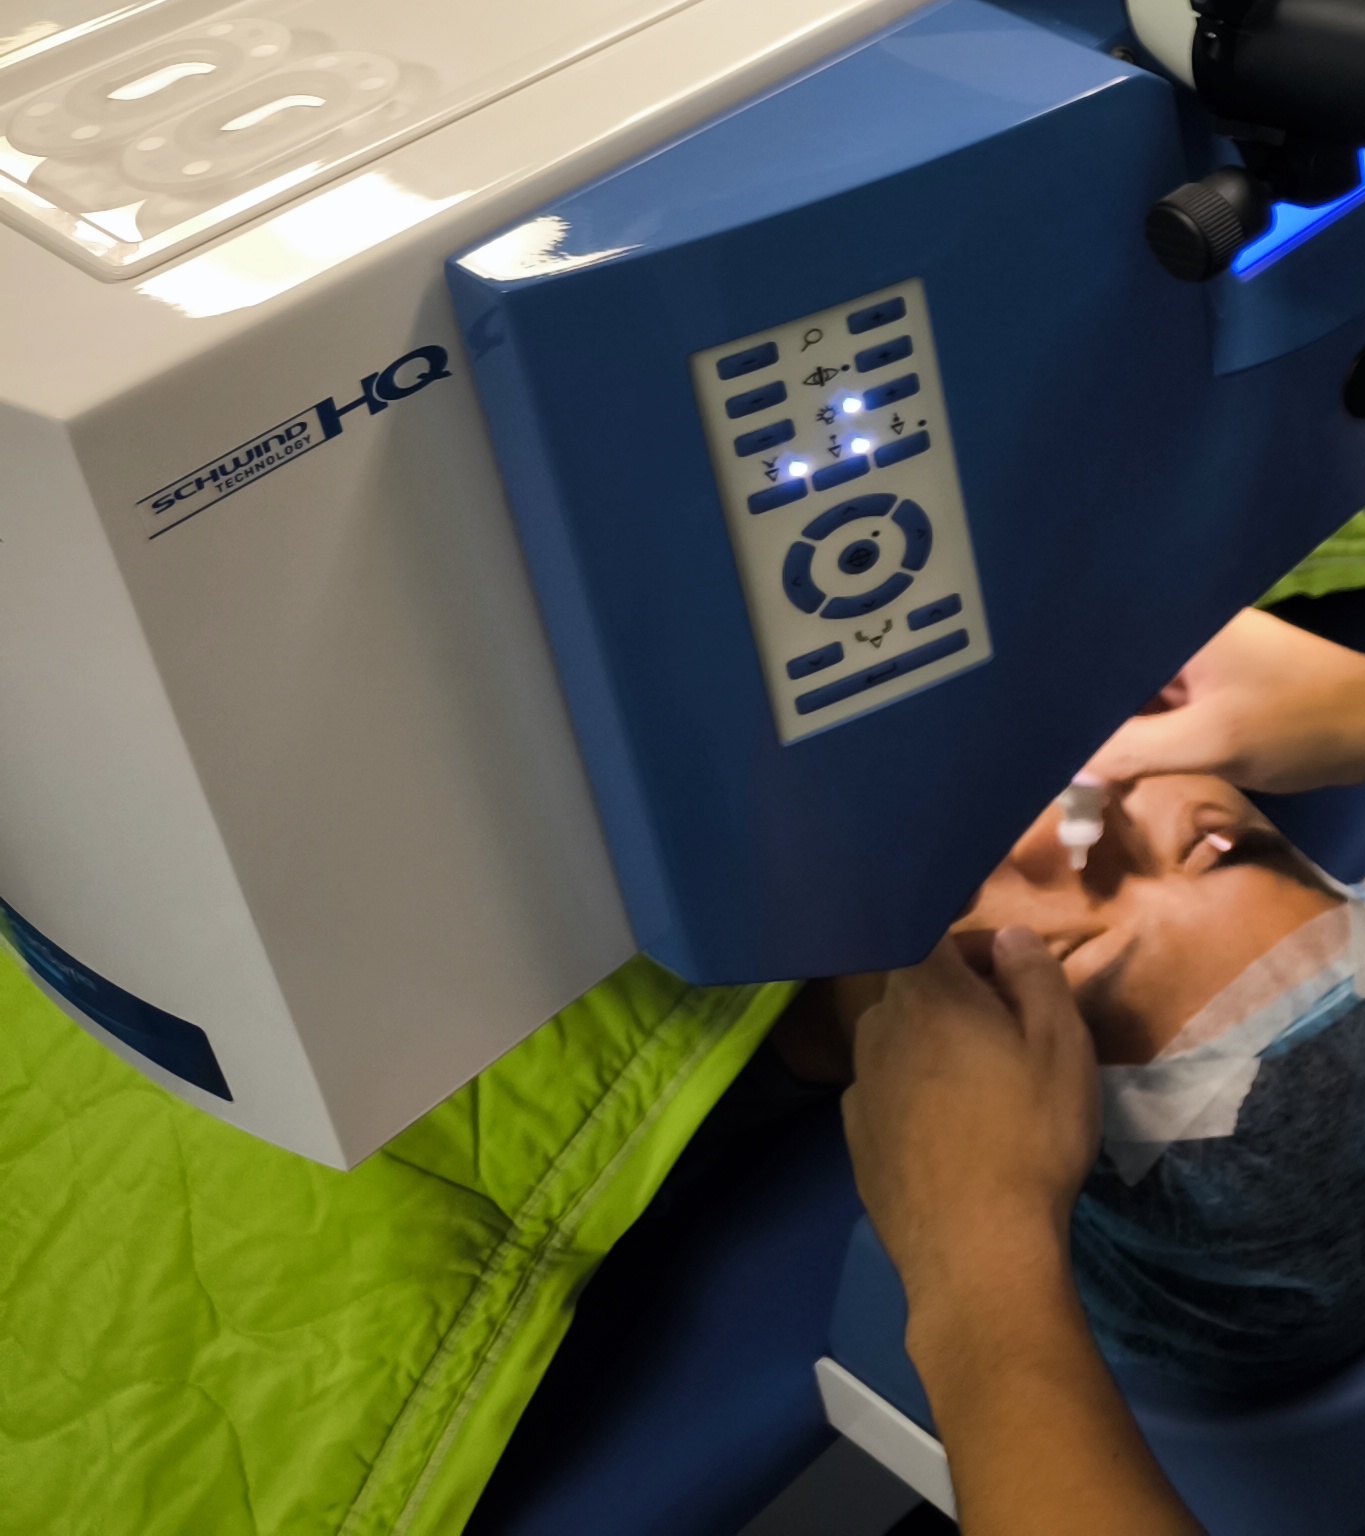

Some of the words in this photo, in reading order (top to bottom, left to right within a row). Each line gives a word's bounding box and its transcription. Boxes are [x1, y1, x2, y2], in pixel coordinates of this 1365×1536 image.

[315, 344, 452, 442] HQ
[151, 420, 308, 515] SCHWIND
[214, 434, 312, 493] TECHNOLOGY
